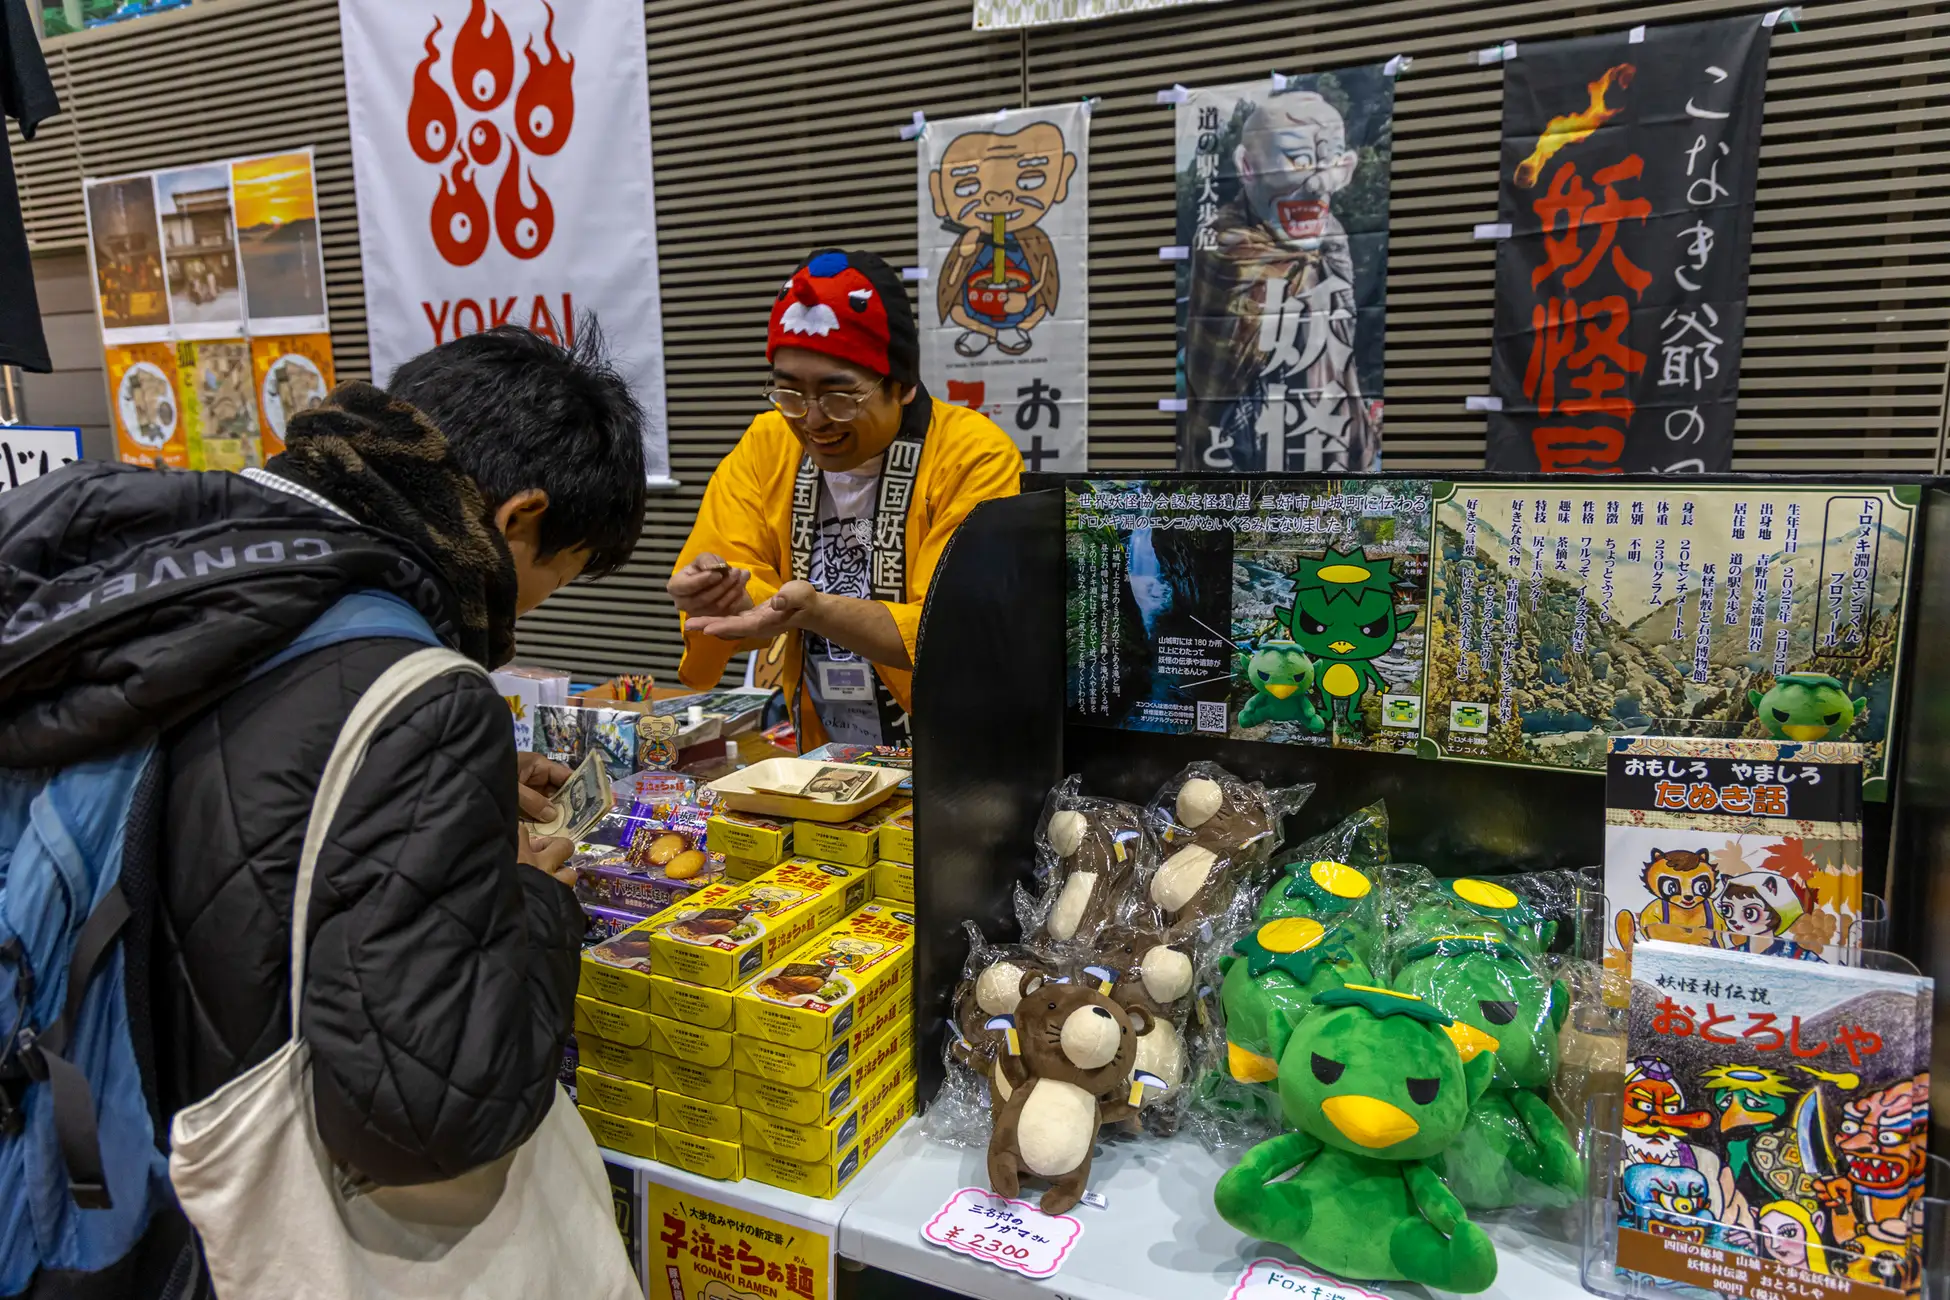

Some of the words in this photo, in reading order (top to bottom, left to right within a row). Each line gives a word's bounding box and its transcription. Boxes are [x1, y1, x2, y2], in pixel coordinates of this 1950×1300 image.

[1196, 107, 1220, 251] 道の駅大歩危
[1078, 493, 1251, 511] 世界妖怪協会認定怪遺産
[1261, 494, 1427, 513] 三好市山城町に伝わる
[1534, 500, 1548, 524] 特技
[1557, 500, 1571, 524] 趣味
[1582, 500, 1595, 525] 性格
[1606, 500, 1620, 525] 特徴
[1631, 501, 1644, 526] 性別
[1656, 501, 1669, 526] 体重
[1681, 501, 1695, 526] 身長
[1731, 503, 1747, 540] 居住地
[1758, 503, 1774, 540] 出身地
[1464, 499, 1478, 557] 好きな言葉
[1508, 499, 1524, 567] 好きな食べ物
[1784, 503, 1800, 553] 生年月日
[1555, 536, 1568, 571] 茶摘み
[1627, 538, 1641, 562] 不明
[1530, 536, 1545, 611] 尻子玉ハンター
[1600, 538, 1618, 623] ちょっとふっくら
[1650, 539, 1666, 606] 230グラム
[1671, 539, 1691, 641] 20センチメートル
[1724, 553, 1744, 625] 道の駅大歩危
[1846, 500, 1876, 643] ドロメキ淵のエンコくん
[1749, 553, 1770, 652] 吉野川支流藤川谷
[1778, 566, 1794, 624] 2025年
[1823, 571, 1846, 648] プロフィール
[1480, 585, 1496, 670] もちろんキュウリ
[1573, 585, 1589, 654] イタズラ好き
[1693, 563, 1716, 682] 妖怪屋敷と石の博物館
[1158, 636, 1193, 646] 山城町には
[1194, 638, 1207, 646] 180
[1158, 646, 1205, 656] 以上にわたって
[1772, 629, 1789, 676] 2月2日
[1158, 656, 1221, 668] 妖怪の伝承や遺跡が
[1624, 758, 1709, 779] おもしろ
[1731, 763, 1822, 785] やましろ
[1654, 780, 1789, 817] たぬき話
[1655, 973, 1772, 1006] 妖怪村伝説
[1651, 996, 1883, 1067] おとろしや
[689, 1207, 785, 1246] 大歩危みやげの新定番
[967, 1203, 1024, 1225] 三名村の
[660, 1211, 815, 1300] 子泣きらぁ麺
[967, 1233, 1030, 1260] 2300
[693, 1261, 735, 1284] KONAKI
[737, 1273, 778, 1299] RAMEN
[1687, 1258, 1748, 1283] 妖怪村伝説
[1760, 1274, 1825, 1300] おとろしや
[1713, 1278, 1743, 1296] 900円
